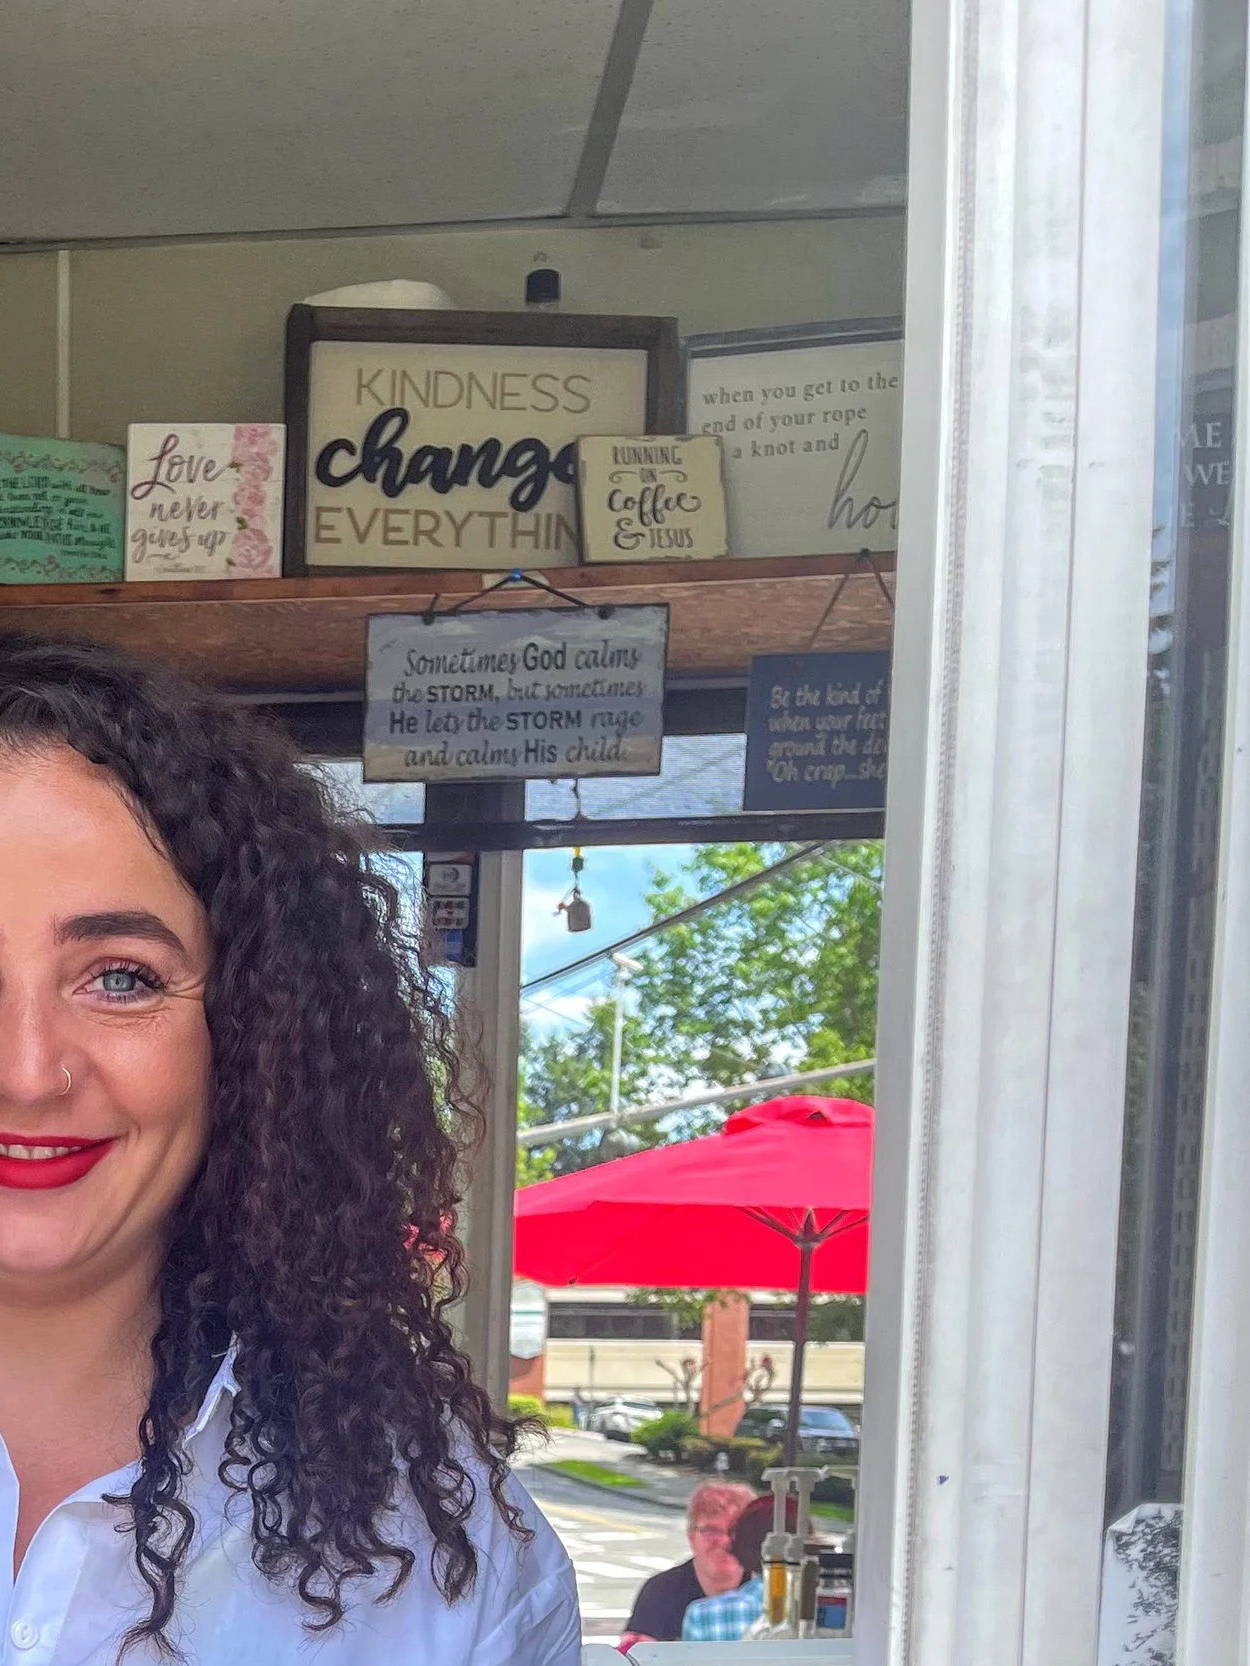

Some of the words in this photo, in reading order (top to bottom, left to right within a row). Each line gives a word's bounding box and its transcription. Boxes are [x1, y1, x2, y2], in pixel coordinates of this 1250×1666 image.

[355, 367, 591, 414] KINDNESS
[701, 385, 754, 405] when
[761, 384, 796, 406] you
[803, 380, 832, 402] get
[840, 376, 860, 393] to
[867, 371, 899, 391] the
[701, 413, 736, 434] end
[743, 410, 763, 431] of
[769, 409, 816, 433] your
[822, 405, 868, 427] rope
[612, 445, 683, 465] RUNNING
[750, 438, 797, 458] knot
[803, 432, 841, 453] and
[131, 433, 230, 500] Love
[149, 496, 225, 523] never
[608, 484, 702, 526] Coffee
[131, 525, 193, 564] gives
[197, 529, 232, 557] up
[613, 518, 646, 550] &
[649, 527, 694, 549] JESUS
[403, 648, 519, 678] Sometimes
[522, 641, 567, 672] God
[574, 640, 641, 671] calms
[392, 681, 426, 705] the
[427, 684, 500, 705] STORM,
[507, 678, 543, 701] but
[544, 677, 646, 702] sometimes
[389, 710, 418, 734] He
[425, 708, 465, 735] lets
[467, 707, 500, 733] the
[505, 710, 582, 731] STORM
[590, 708, 642, 737] rage
[404, 740, 449, 767] and
[452, 739, 518, 768] calms
[524, 738, 558, 764] His
